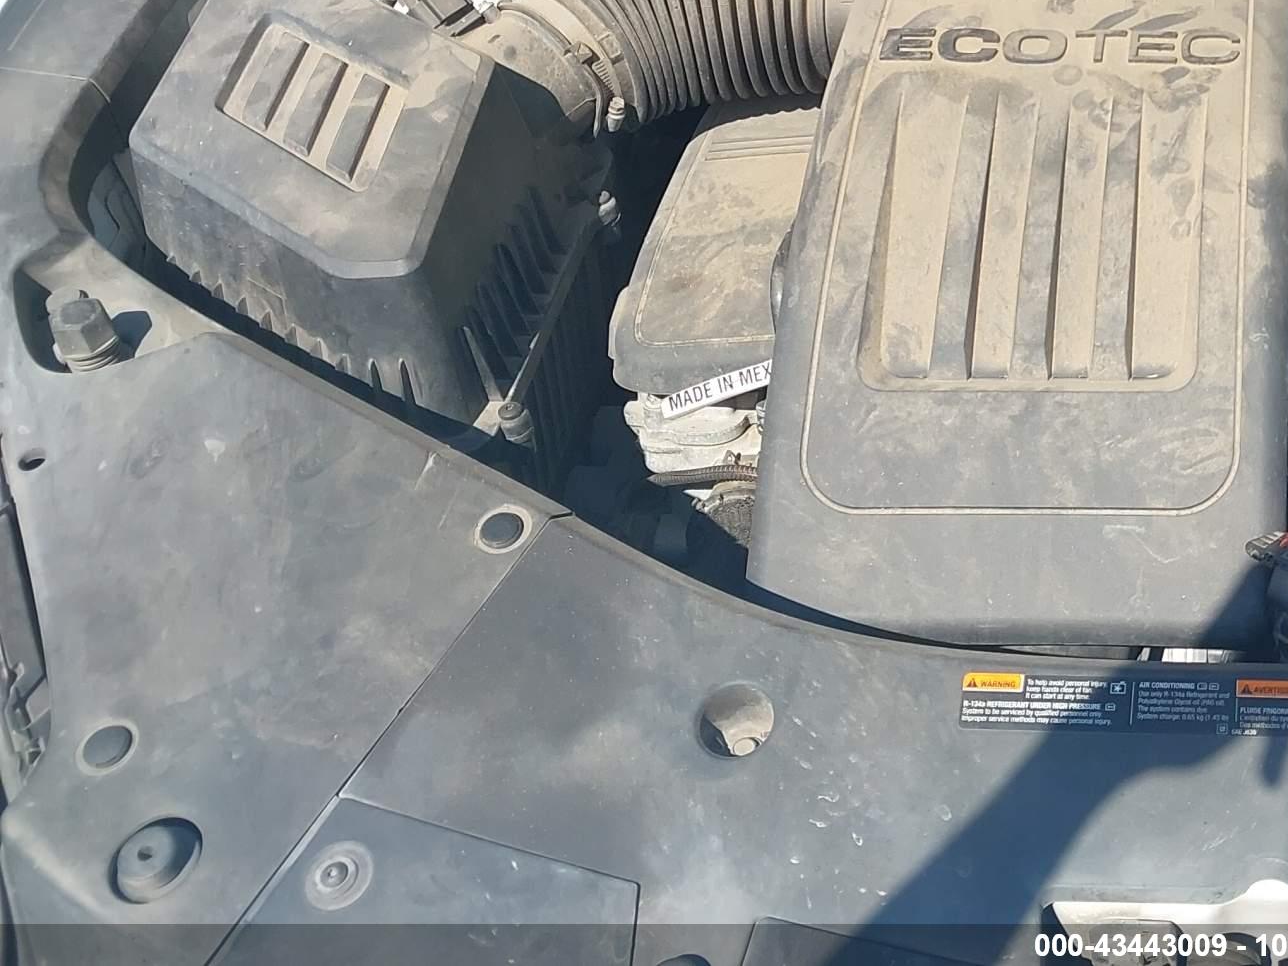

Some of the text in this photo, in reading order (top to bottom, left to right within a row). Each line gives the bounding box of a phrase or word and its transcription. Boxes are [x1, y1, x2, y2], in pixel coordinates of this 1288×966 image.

[878, 27, 1241, 64] ECOTEC
[668, 380, 714, 412] MADE
[717, 376, 735, 393] IN
[980, 680, 1016, 688] WARNING
